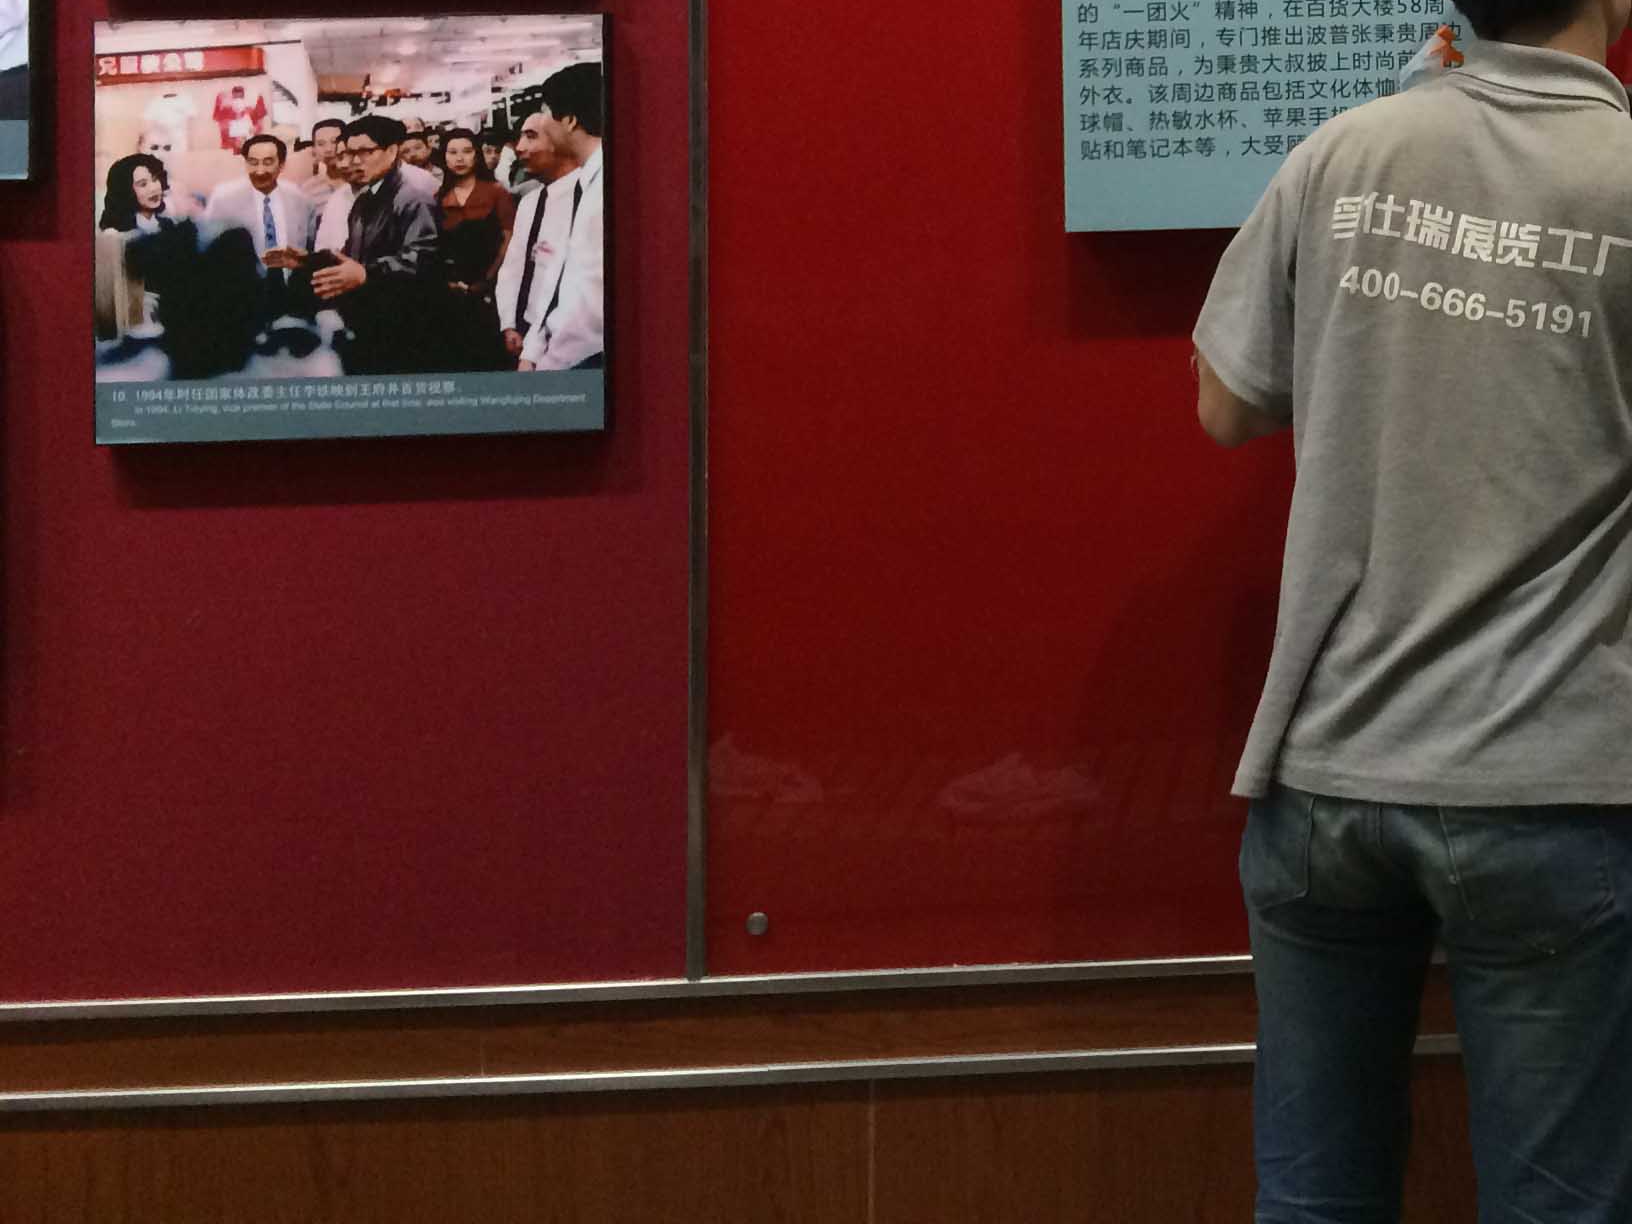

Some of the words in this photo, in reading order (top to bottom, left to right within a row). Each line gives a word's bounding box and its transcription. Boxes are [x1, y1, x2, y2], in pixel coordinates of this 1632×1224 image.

[1079, 50, 1463, 79] 系列商品，为秉贵大叔披上时尚前
[1080, 77, 1399, 105] 外衣。该周边商品包括文化体恤
[1339, 265, 1592, 339] 400-666-5191
